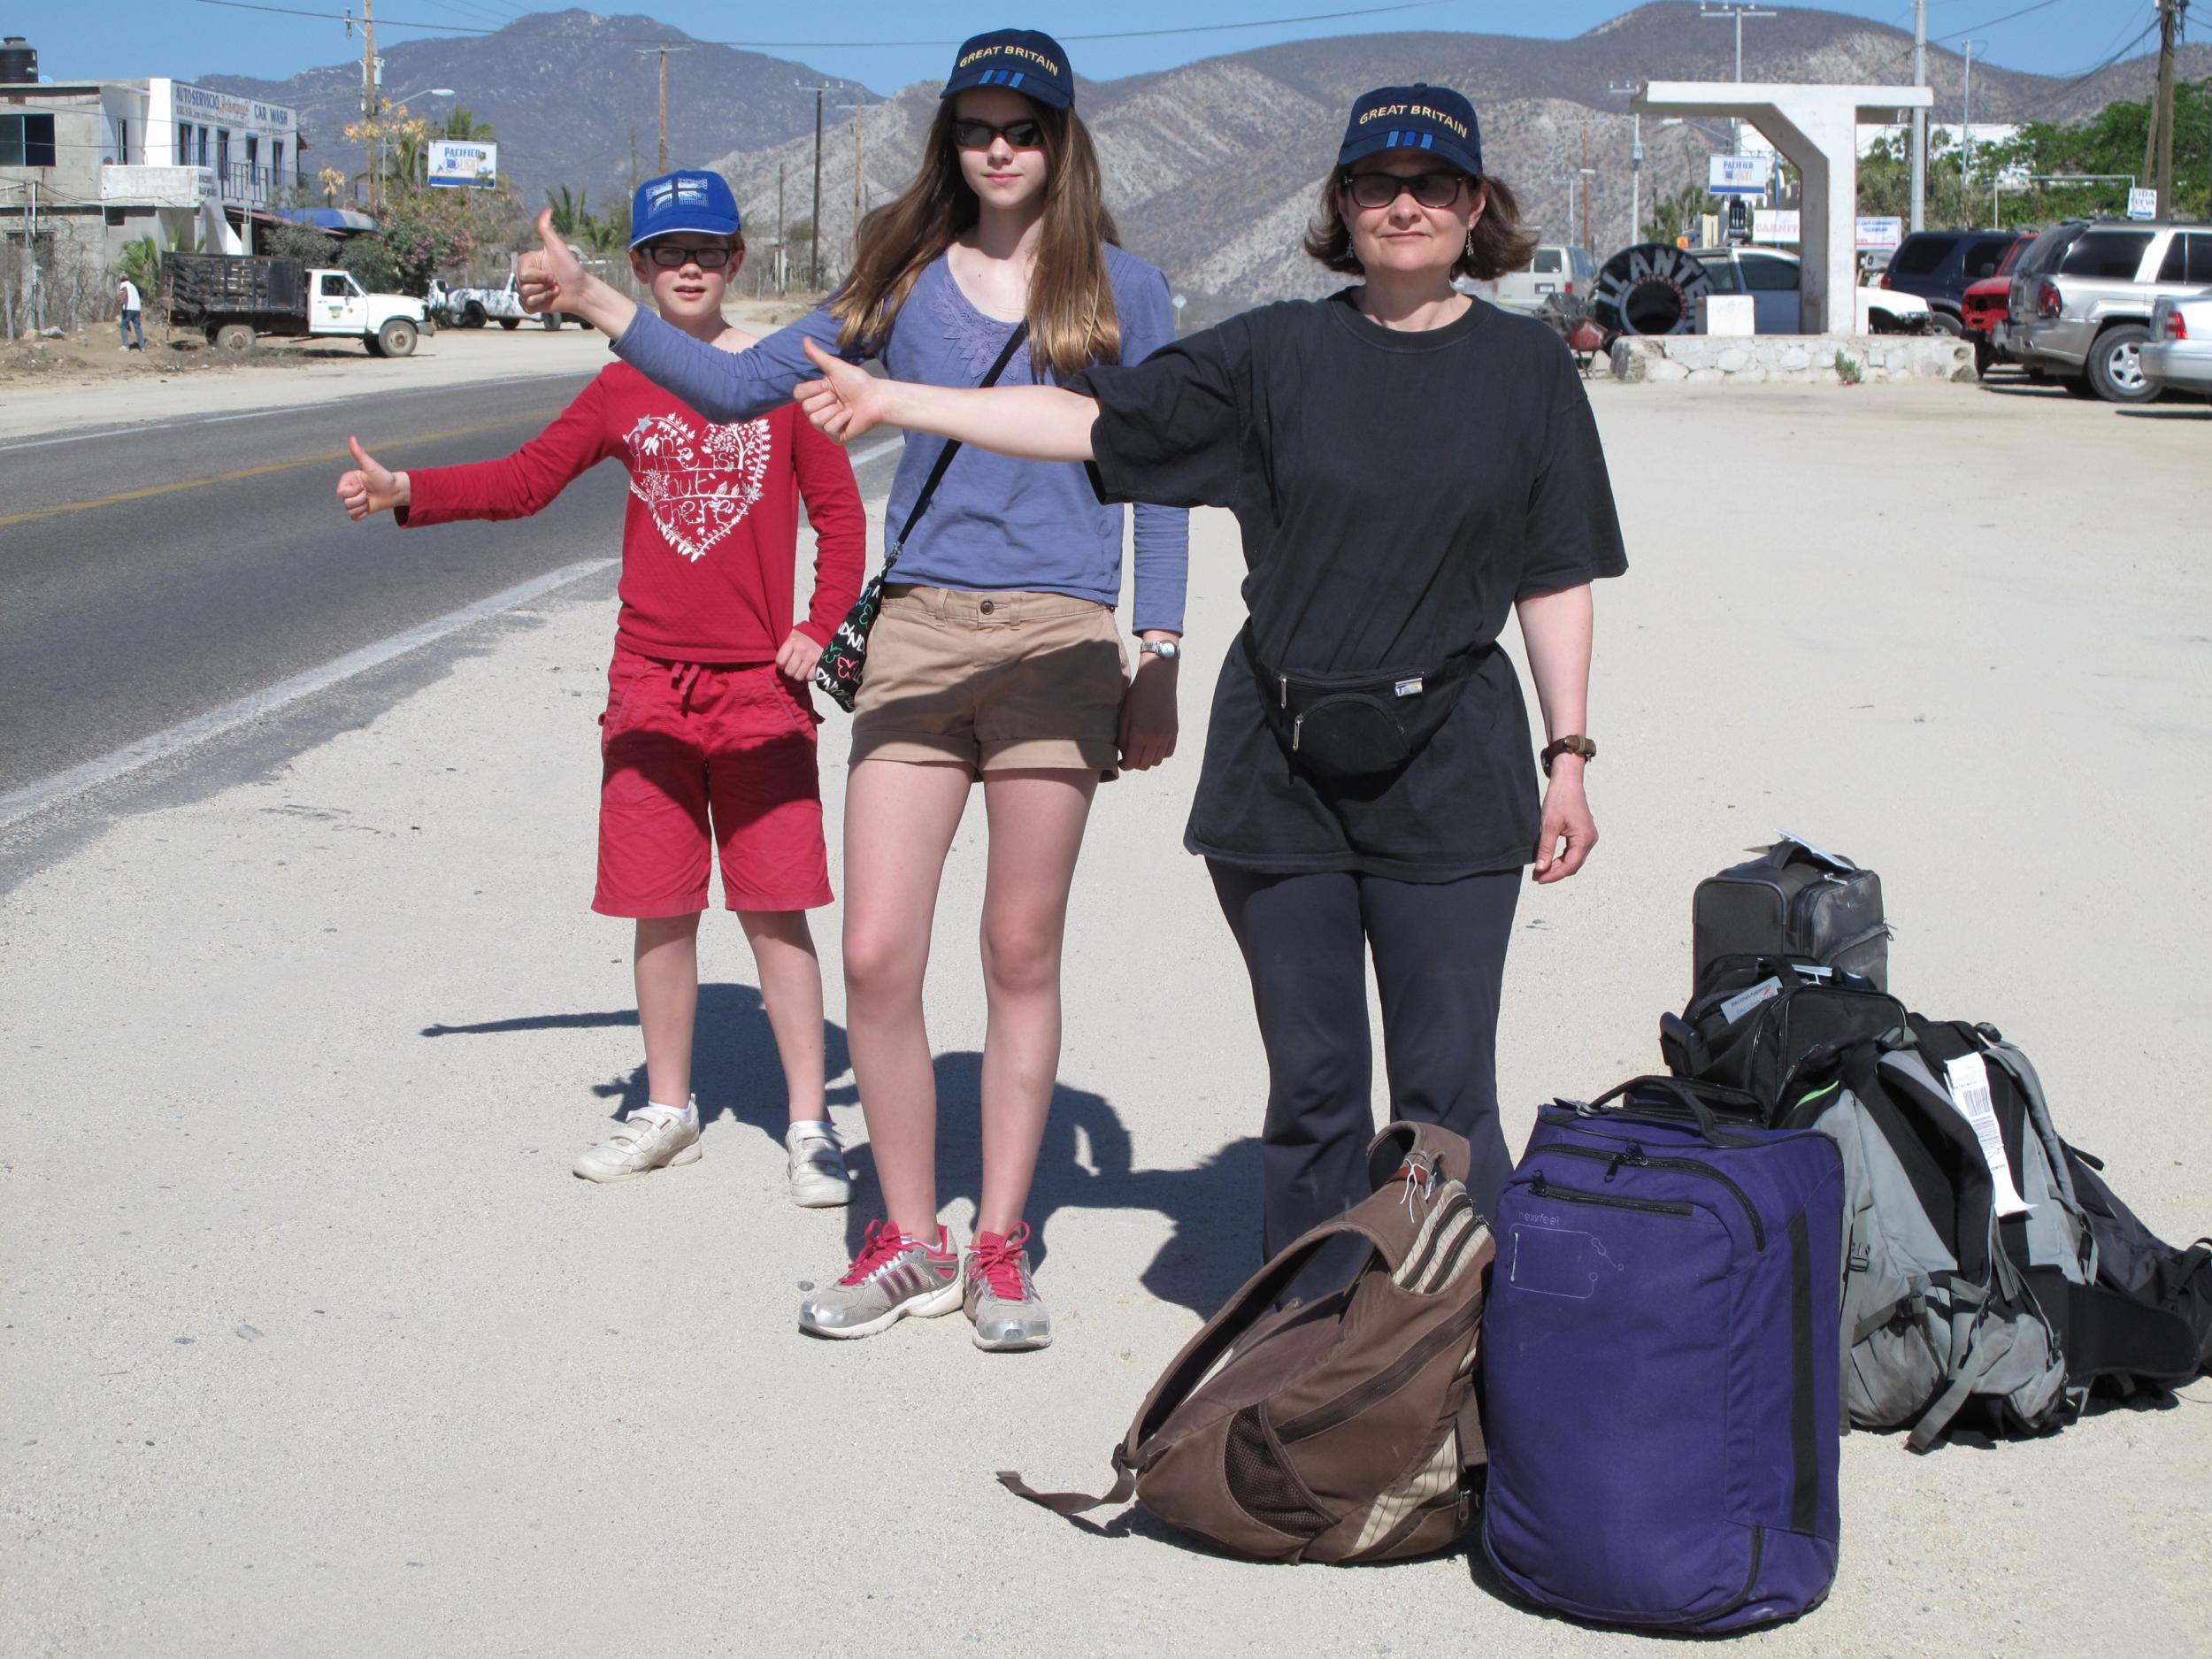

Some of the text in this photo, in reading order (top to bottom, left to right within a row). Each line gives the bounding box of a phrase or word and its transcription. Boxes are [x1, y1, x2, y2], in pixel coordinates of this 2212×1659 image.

[959, 45, 1058, 77] GREAT BRITAIN
[176, 87, 220, 111] AUTOSERVICIO
[254, 104, 267, 121] CAR
[269, 108, 288, 126] WASH
[1359, 104, 1468, 139] GREAT BRITAIN
[444, 147, 482, 158] PACIFICO
[1724, 160, 1754, 169] PACIFICO
[658, 499, 736, 527] there
[1517, 1211, 1560, 1225] newfeel
